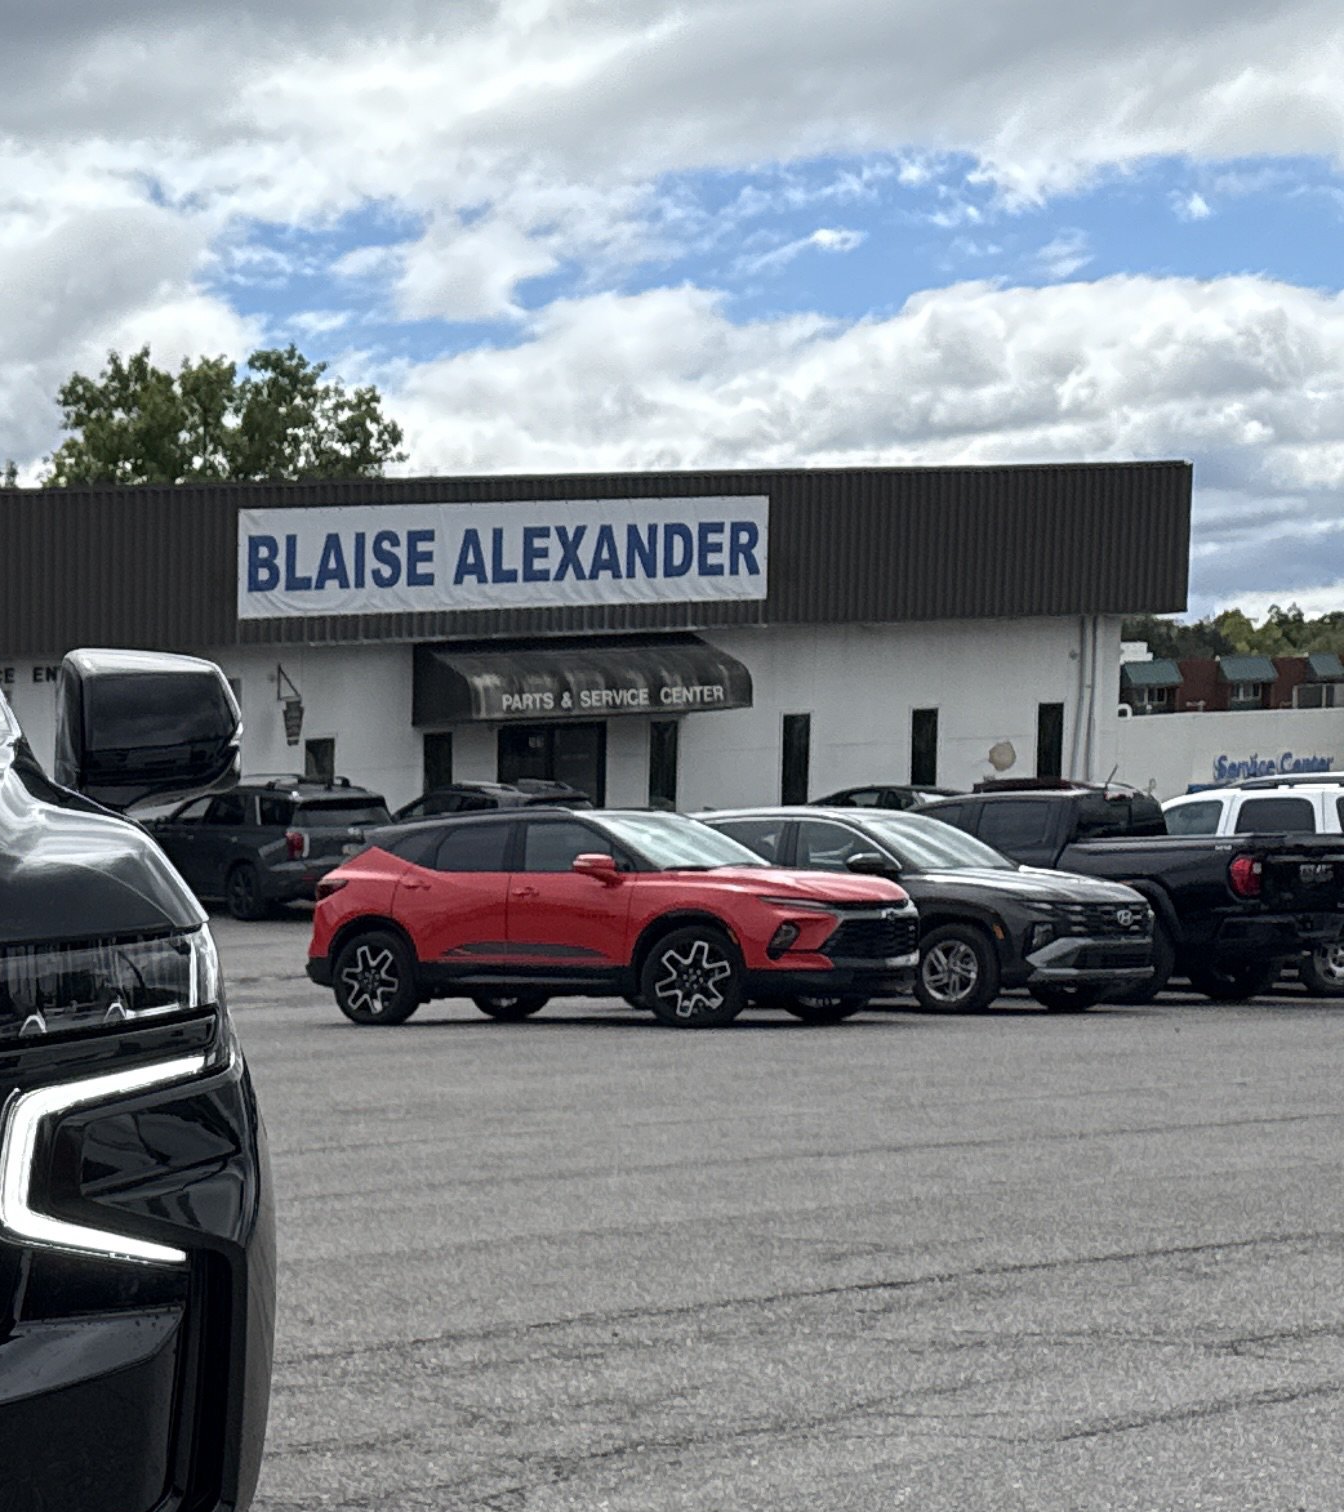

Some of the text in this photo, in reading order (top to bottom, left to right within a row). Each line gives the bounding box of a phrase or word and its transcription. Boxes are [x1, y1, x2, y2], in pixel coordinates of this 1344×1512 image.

[247, 521, 760, 593] BLAISE ALEXANDER
[501, 685, 725, 711] PARTS & SERVICE CENTER
[1215, 751, 1334, 779] Service Center
